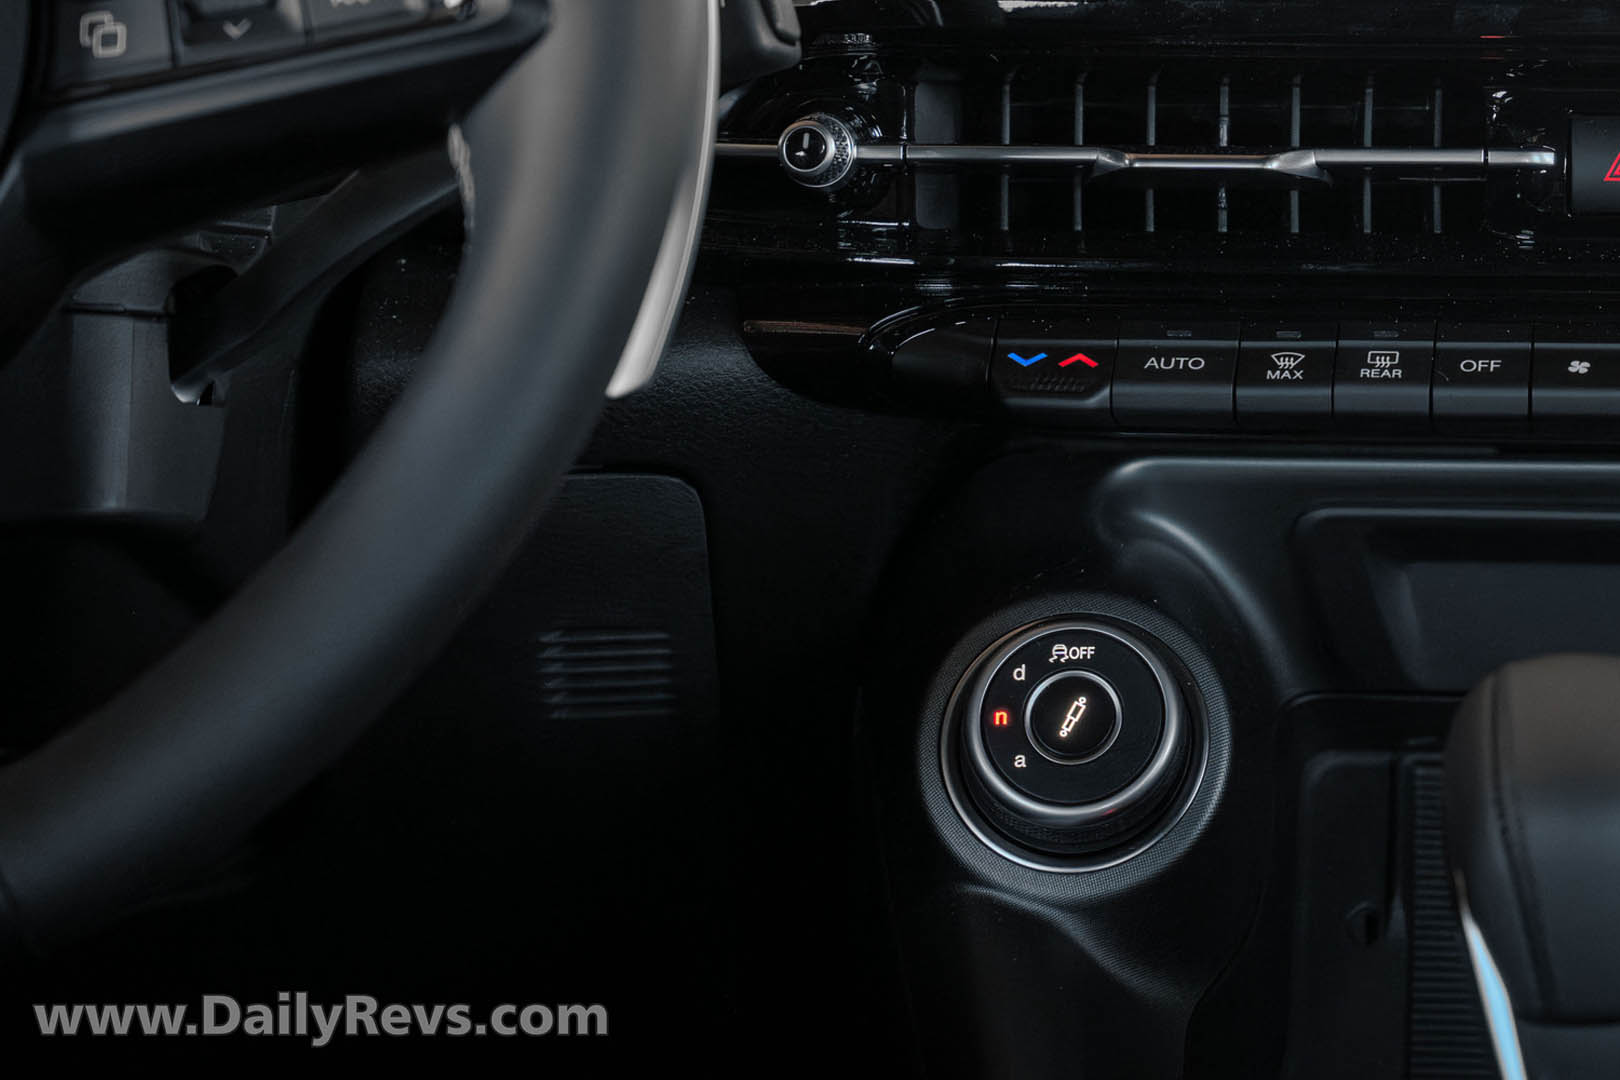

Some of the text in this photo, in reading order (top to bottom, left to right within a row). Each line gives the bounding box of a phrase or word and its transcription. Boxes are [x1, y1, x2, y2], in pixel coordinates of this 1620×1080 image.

[1143, 356, 1206, 371] AUTO
[1459, 358, 1502, 373] OFF
[1266, 369, 1305, 381] MAX
[1359, 368, 1403, 379] REAR
[1069, 647, 1095, 659] OFF
[1013, 664, 1025, 680] d
[994, 711, 1007, 725] n
[1014, 754, 1026, 767] a
